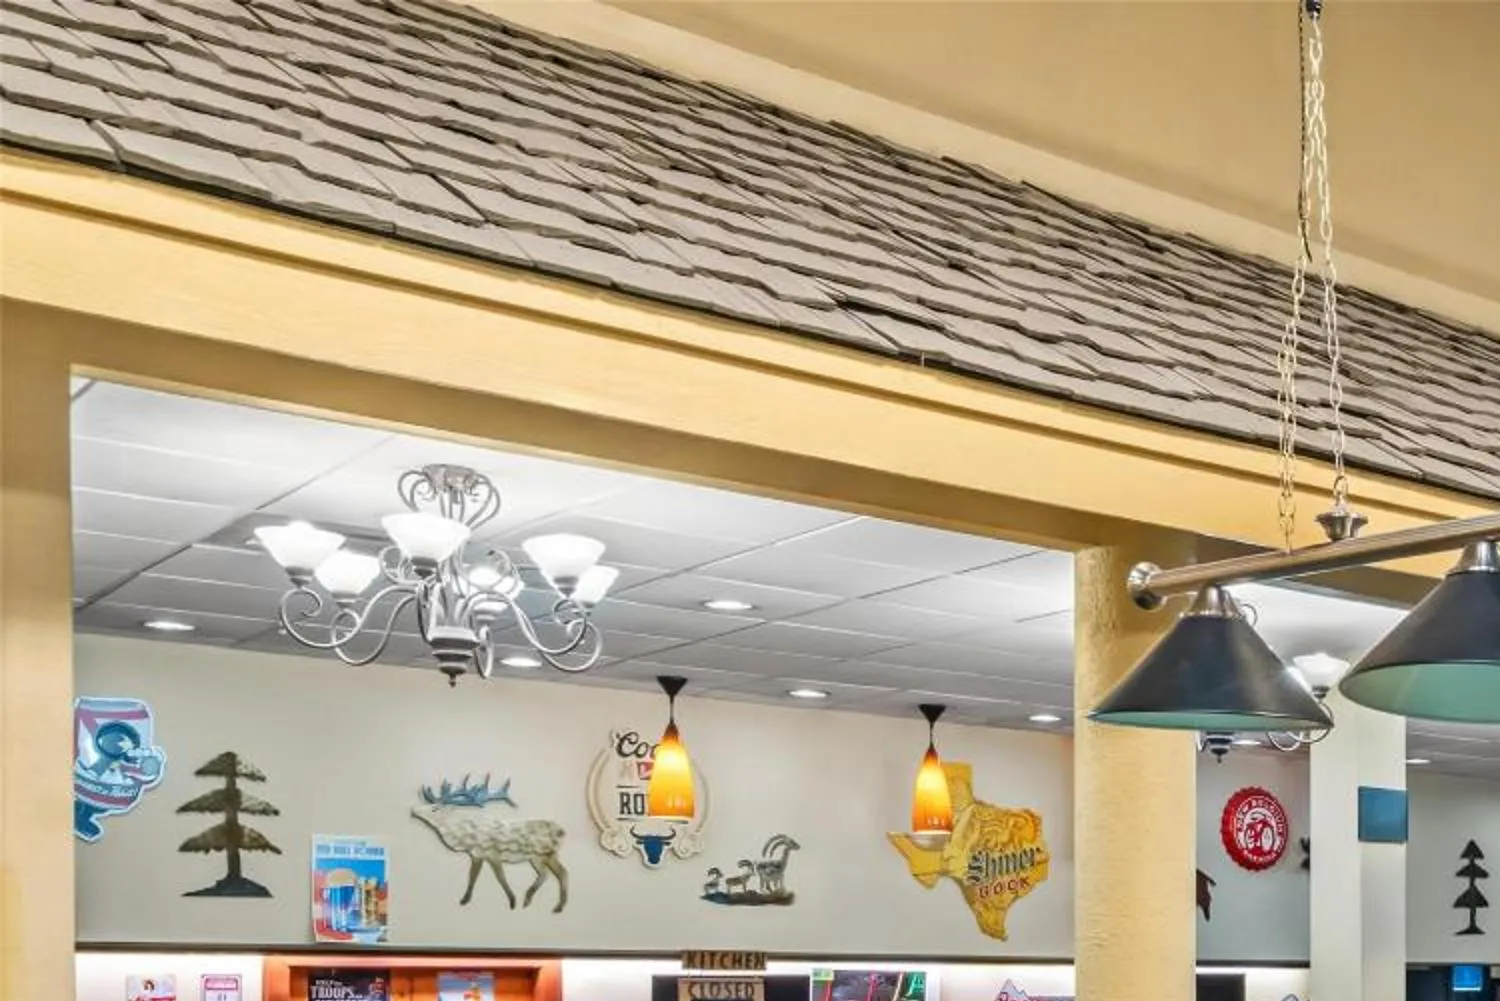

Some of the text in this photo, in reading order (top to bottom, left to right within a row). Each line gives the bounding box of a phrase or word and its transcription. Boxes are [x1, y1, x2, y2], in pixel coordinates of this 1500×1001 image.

[616, 731, 660, 758] Coo
[619, 792, 648, 816] RO
[686, 951, 766, 970] KITCHEN
[687, 981, 755, 998] CLOSED
